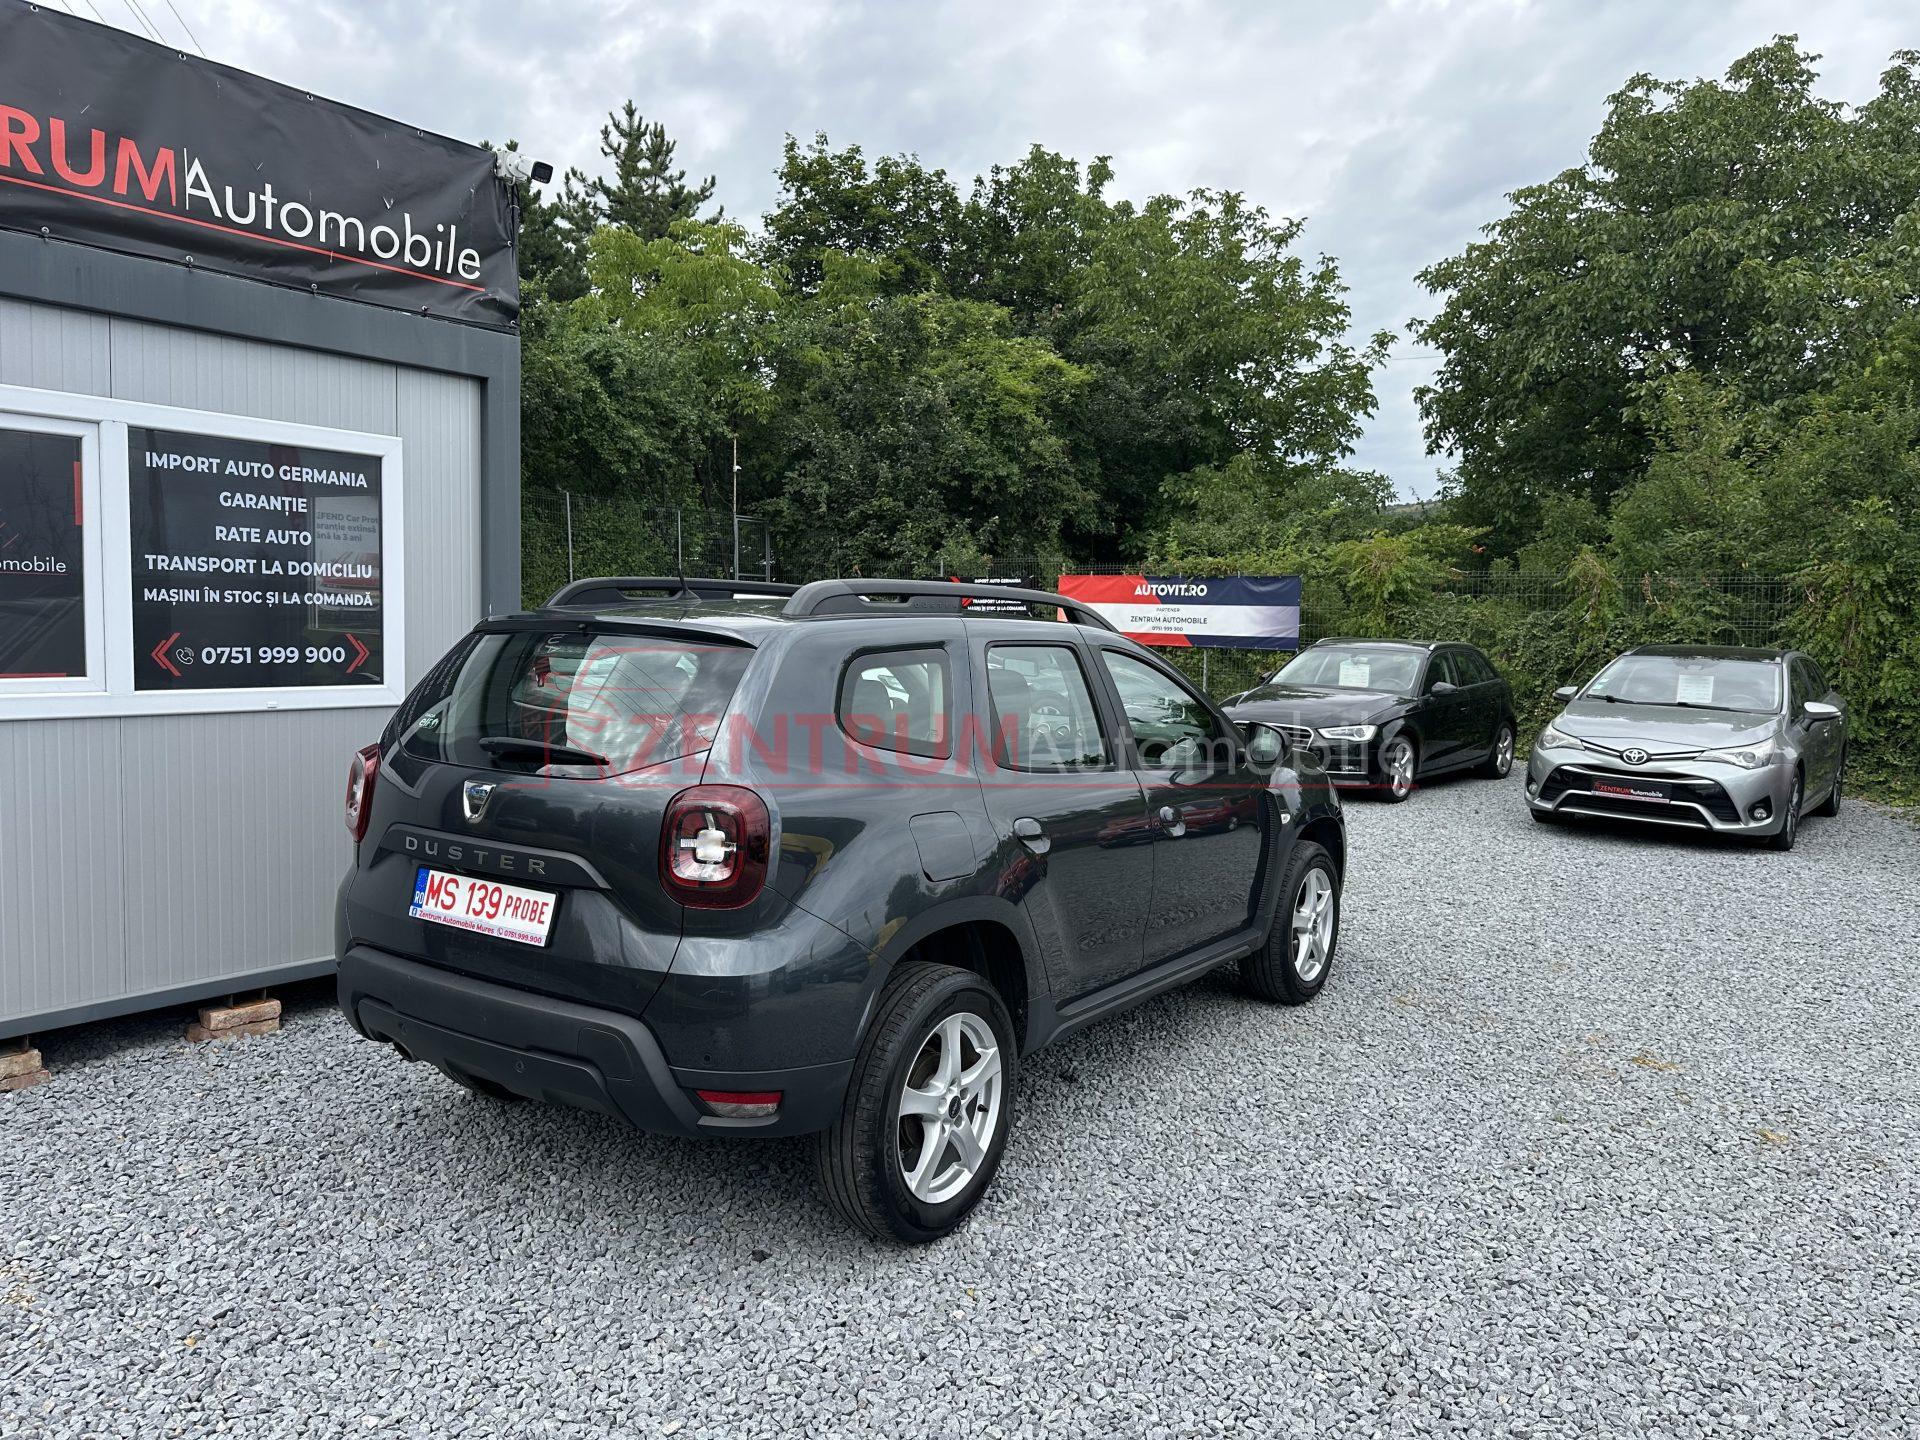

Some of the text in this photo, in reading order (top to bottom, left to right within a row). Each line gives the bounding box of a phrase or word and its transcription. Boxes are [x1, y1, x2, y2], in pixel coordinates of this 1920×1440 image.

[145, 451, 368, 488] IMPORT AUTO GERMANIA
[219, 491, 308, 516] GARANȚIE
[215, 525, 312, 547] RATE AUTO
[144, 554, 372, 579] TRANSPORT LA DOMICILIU
[143, 586, 373, 608] MAȘINI ÎN STOC ȘI LA COMANDĂ
[1134, 584, 1208, 597] AUTOVIT.RO
[1130, 615, 1208, 625] ZENTRUM AUTOMOBILE
[201, 646, 346, 665] 0751 999 900
[405, 836, 546, 875] DUSTER
[414, 890, 425, 904] RO
[424, 874, 549, 925] MS 139 PROBE
[418, 910, 442, 922] Zentrum
[442, 915, 476, 930] Automobile
